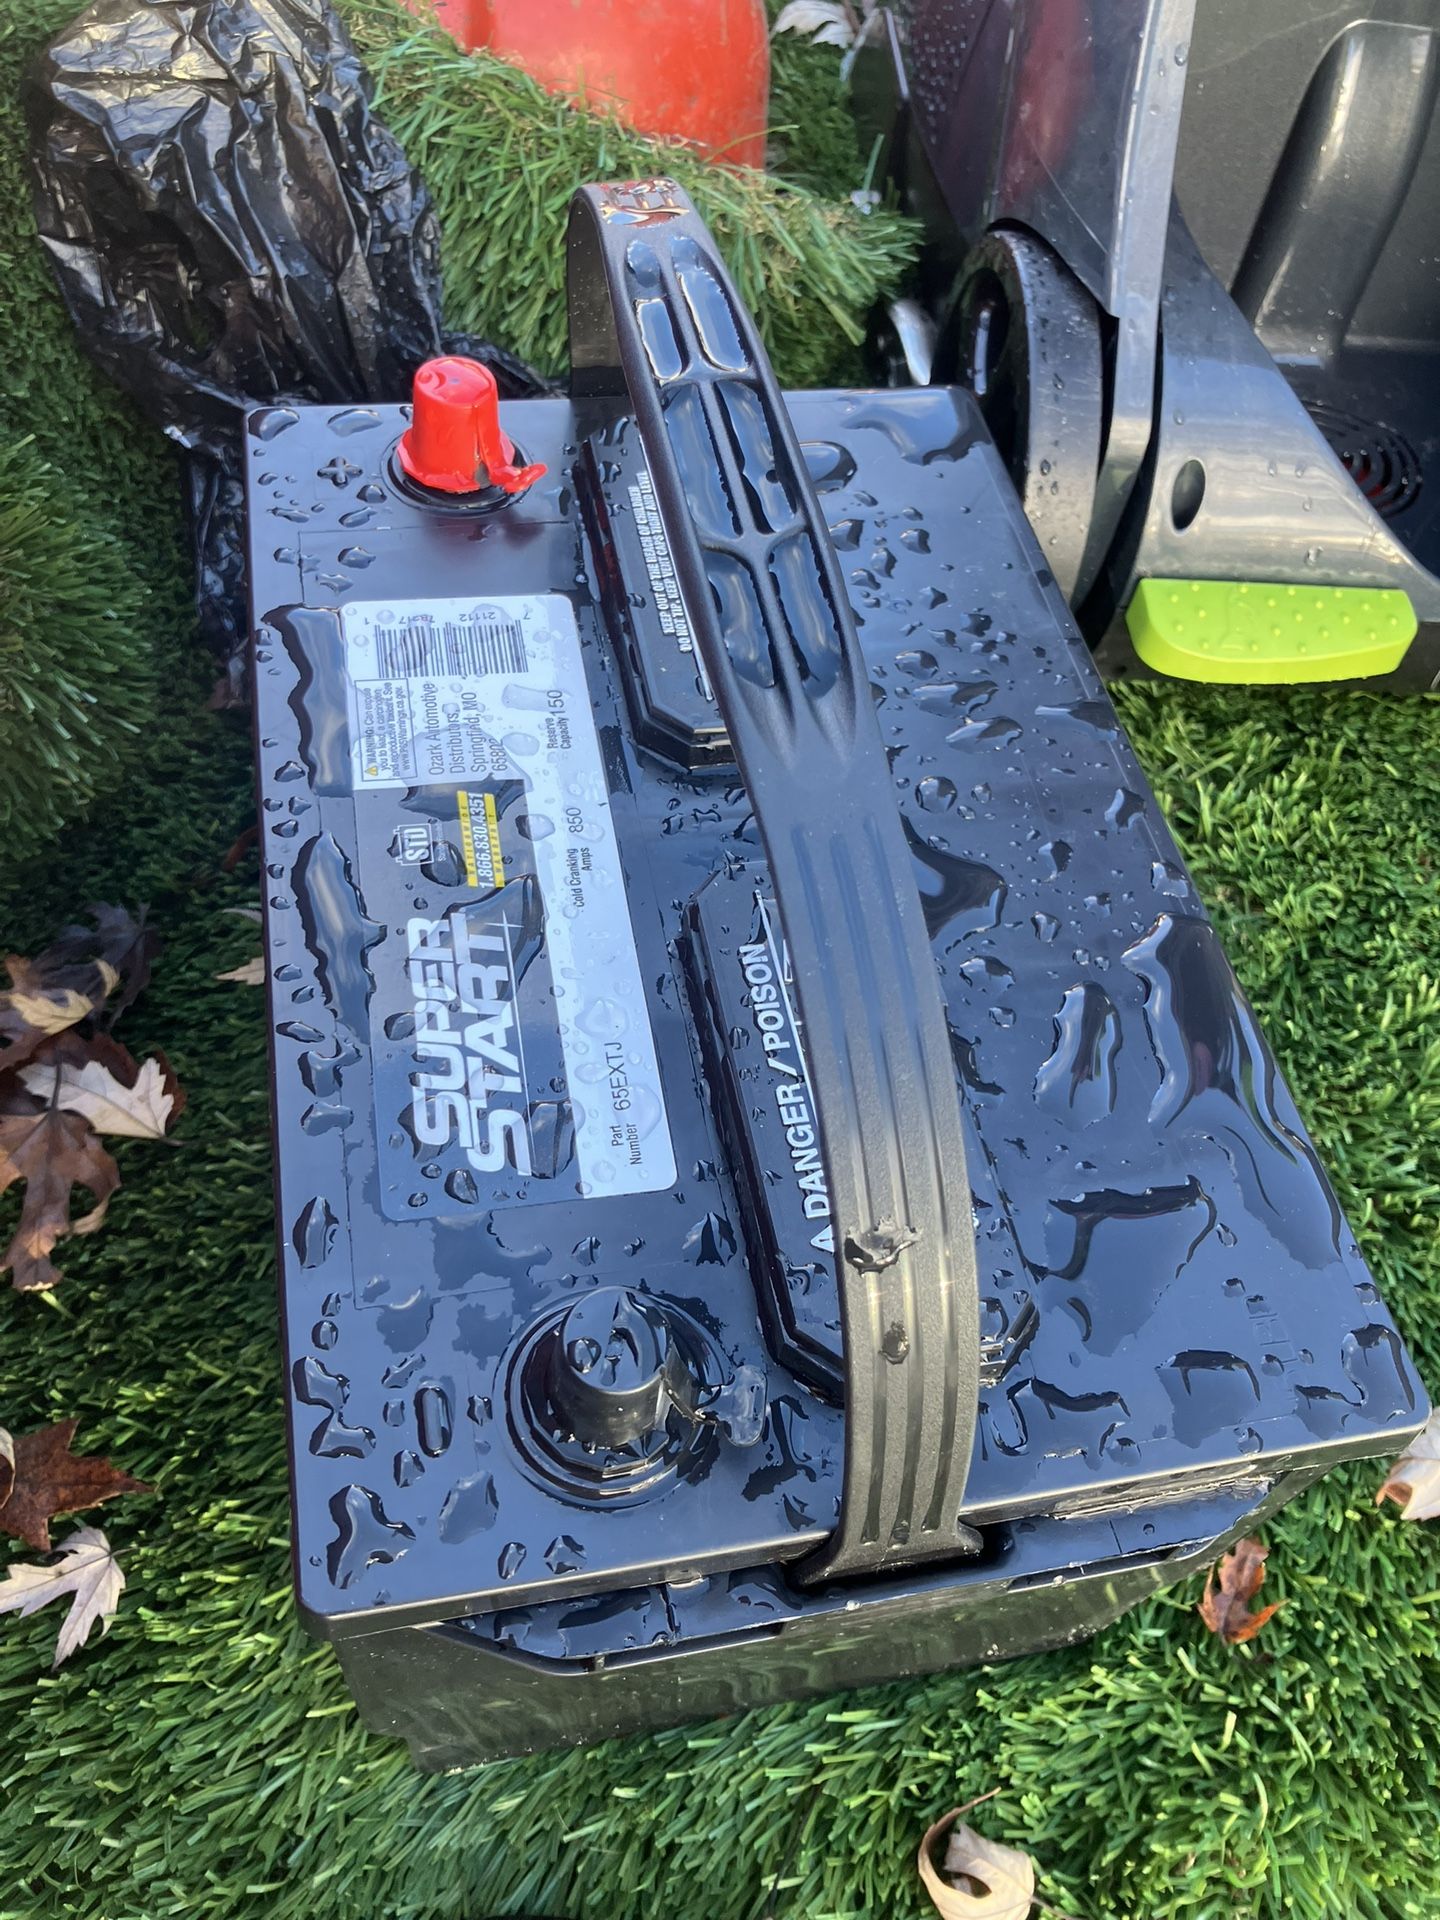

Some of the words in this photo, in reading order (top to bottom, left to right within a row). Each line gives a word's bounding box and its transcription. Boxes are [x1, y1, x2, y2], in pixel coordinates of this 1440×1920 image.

[636, 471, 652, 494] LEVEL
[628, 486, 648, 524] CHILDREN
[642, 494, 657, 511] AND
[637, 525, 650, 535] OF
[646, 511, 662, 534] TIGHT
[640, 536, 657, 562] REACH
[653, 534, 668, 555] CAPS
[646, 563, 662, 580] THE
[658, 556, 674, 577] VENT
[651, 581, 665, 592] OF
[663, 578, 680, 599] KEEP
[654, 592, 669, 610] OUT
[670, 600, 684, 618] TIP.
[459, 611, 496, 622] 21112
[659, 611, 675, 634] KEEP
[673, 619, 689, 636] NOT
[678, 637, 693, 652] DO
[461, 692, 478, 711] MO
[547, 690, 566, 717] 150
[446, 711, 467, 775] Distributors,
[546, 718, 560, 750] Reserve
[558, 717, 572, 751] Capacity
[364, 727, 377, 766] WARNING:
[489, 738, 509, 772] 65802
[380, 757, 391, 771] you
[390, 764, 400, 777] and
[424, 742, 445, 776] Ozark
[565, 807, 584, 834] 850
[403, 827, 430, 861] STD
[468, 792, 495, 888] 1.866.830.4351
[567, 848, 582, 886] Cranking
[581, 847, 594, 872] Amps
[571, 888, 585, 908] Cold
[407, 917, 474, 1148] SUPER
[451, 912, 533, 1176] START
[604, 1041, 632, 1112] 65EXTJ
[611, 1123, 624, 1147] Part
[627, 1122, 642, 1166] Number
